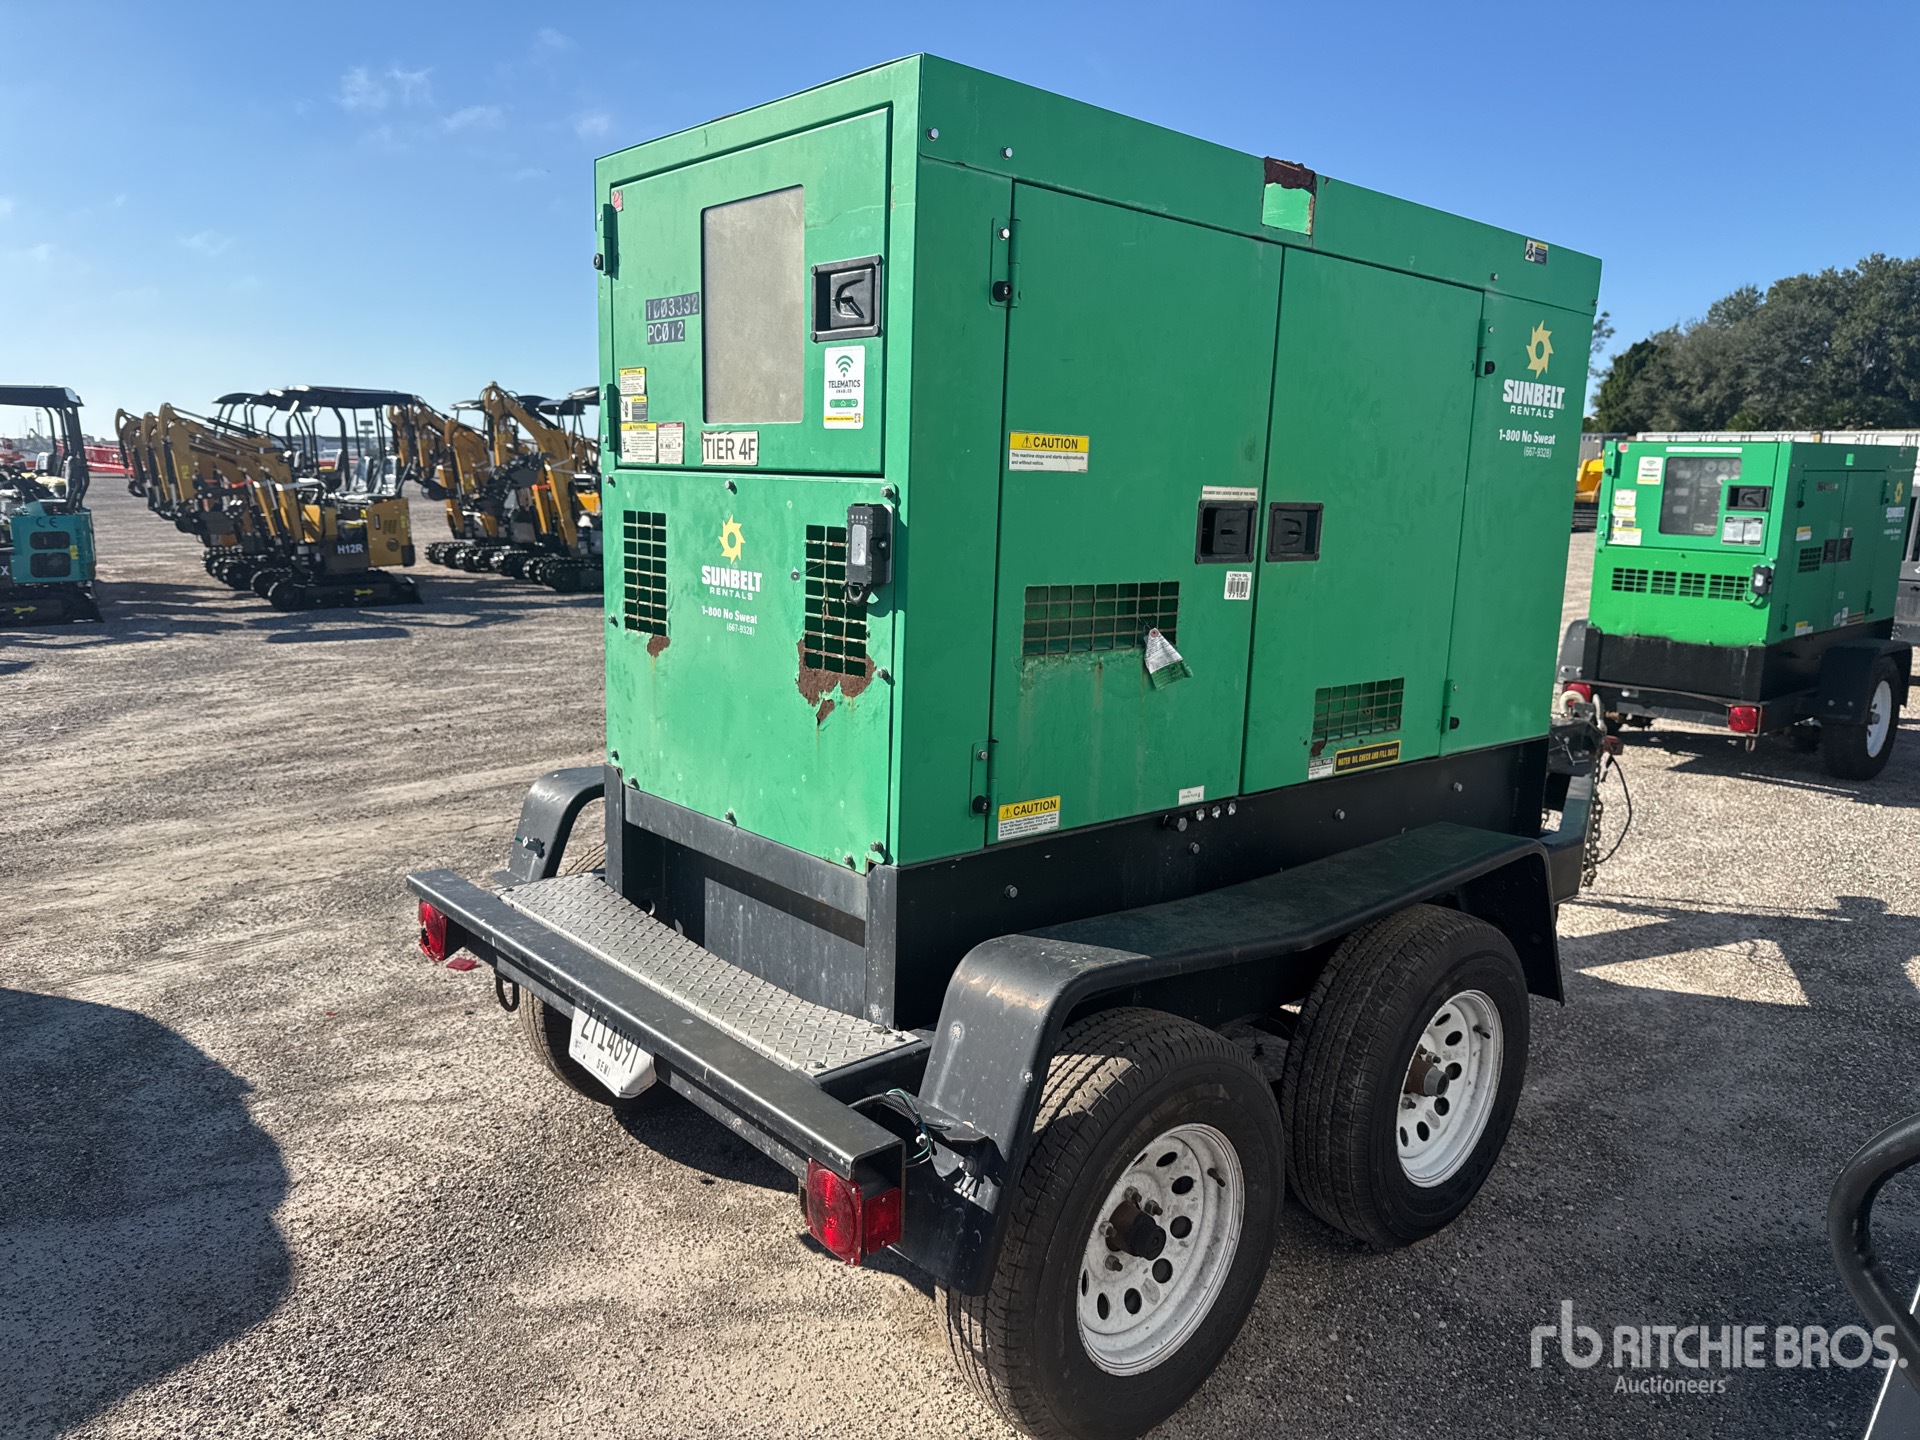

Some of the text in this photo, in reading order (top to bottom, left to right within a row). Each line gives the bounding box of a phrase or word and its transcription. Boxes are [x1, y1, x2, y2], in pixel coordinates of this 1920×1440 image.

[828, 380, 861, 389] TELEMATICS
[1503, 379, 1565, 409] SUNBELT
[1510, 405, 1554, 418] RENTALS
[1034, 437, 1078, 449] CAUTION
[1499, 428, 1556, 445] 1-800 No Sweat
[704, 438, 735, 460] TIER
[739, 438, 756, 460] 4F
[337, 544, 364, 554] H12R
[701, 565, 762, 592] SUNBELT
[710, 587, 753, 600] RENTALS
[702, 605, 758, 624] 1-800 No Sweat
[1014, 799, 1056, 816] CAUTION
